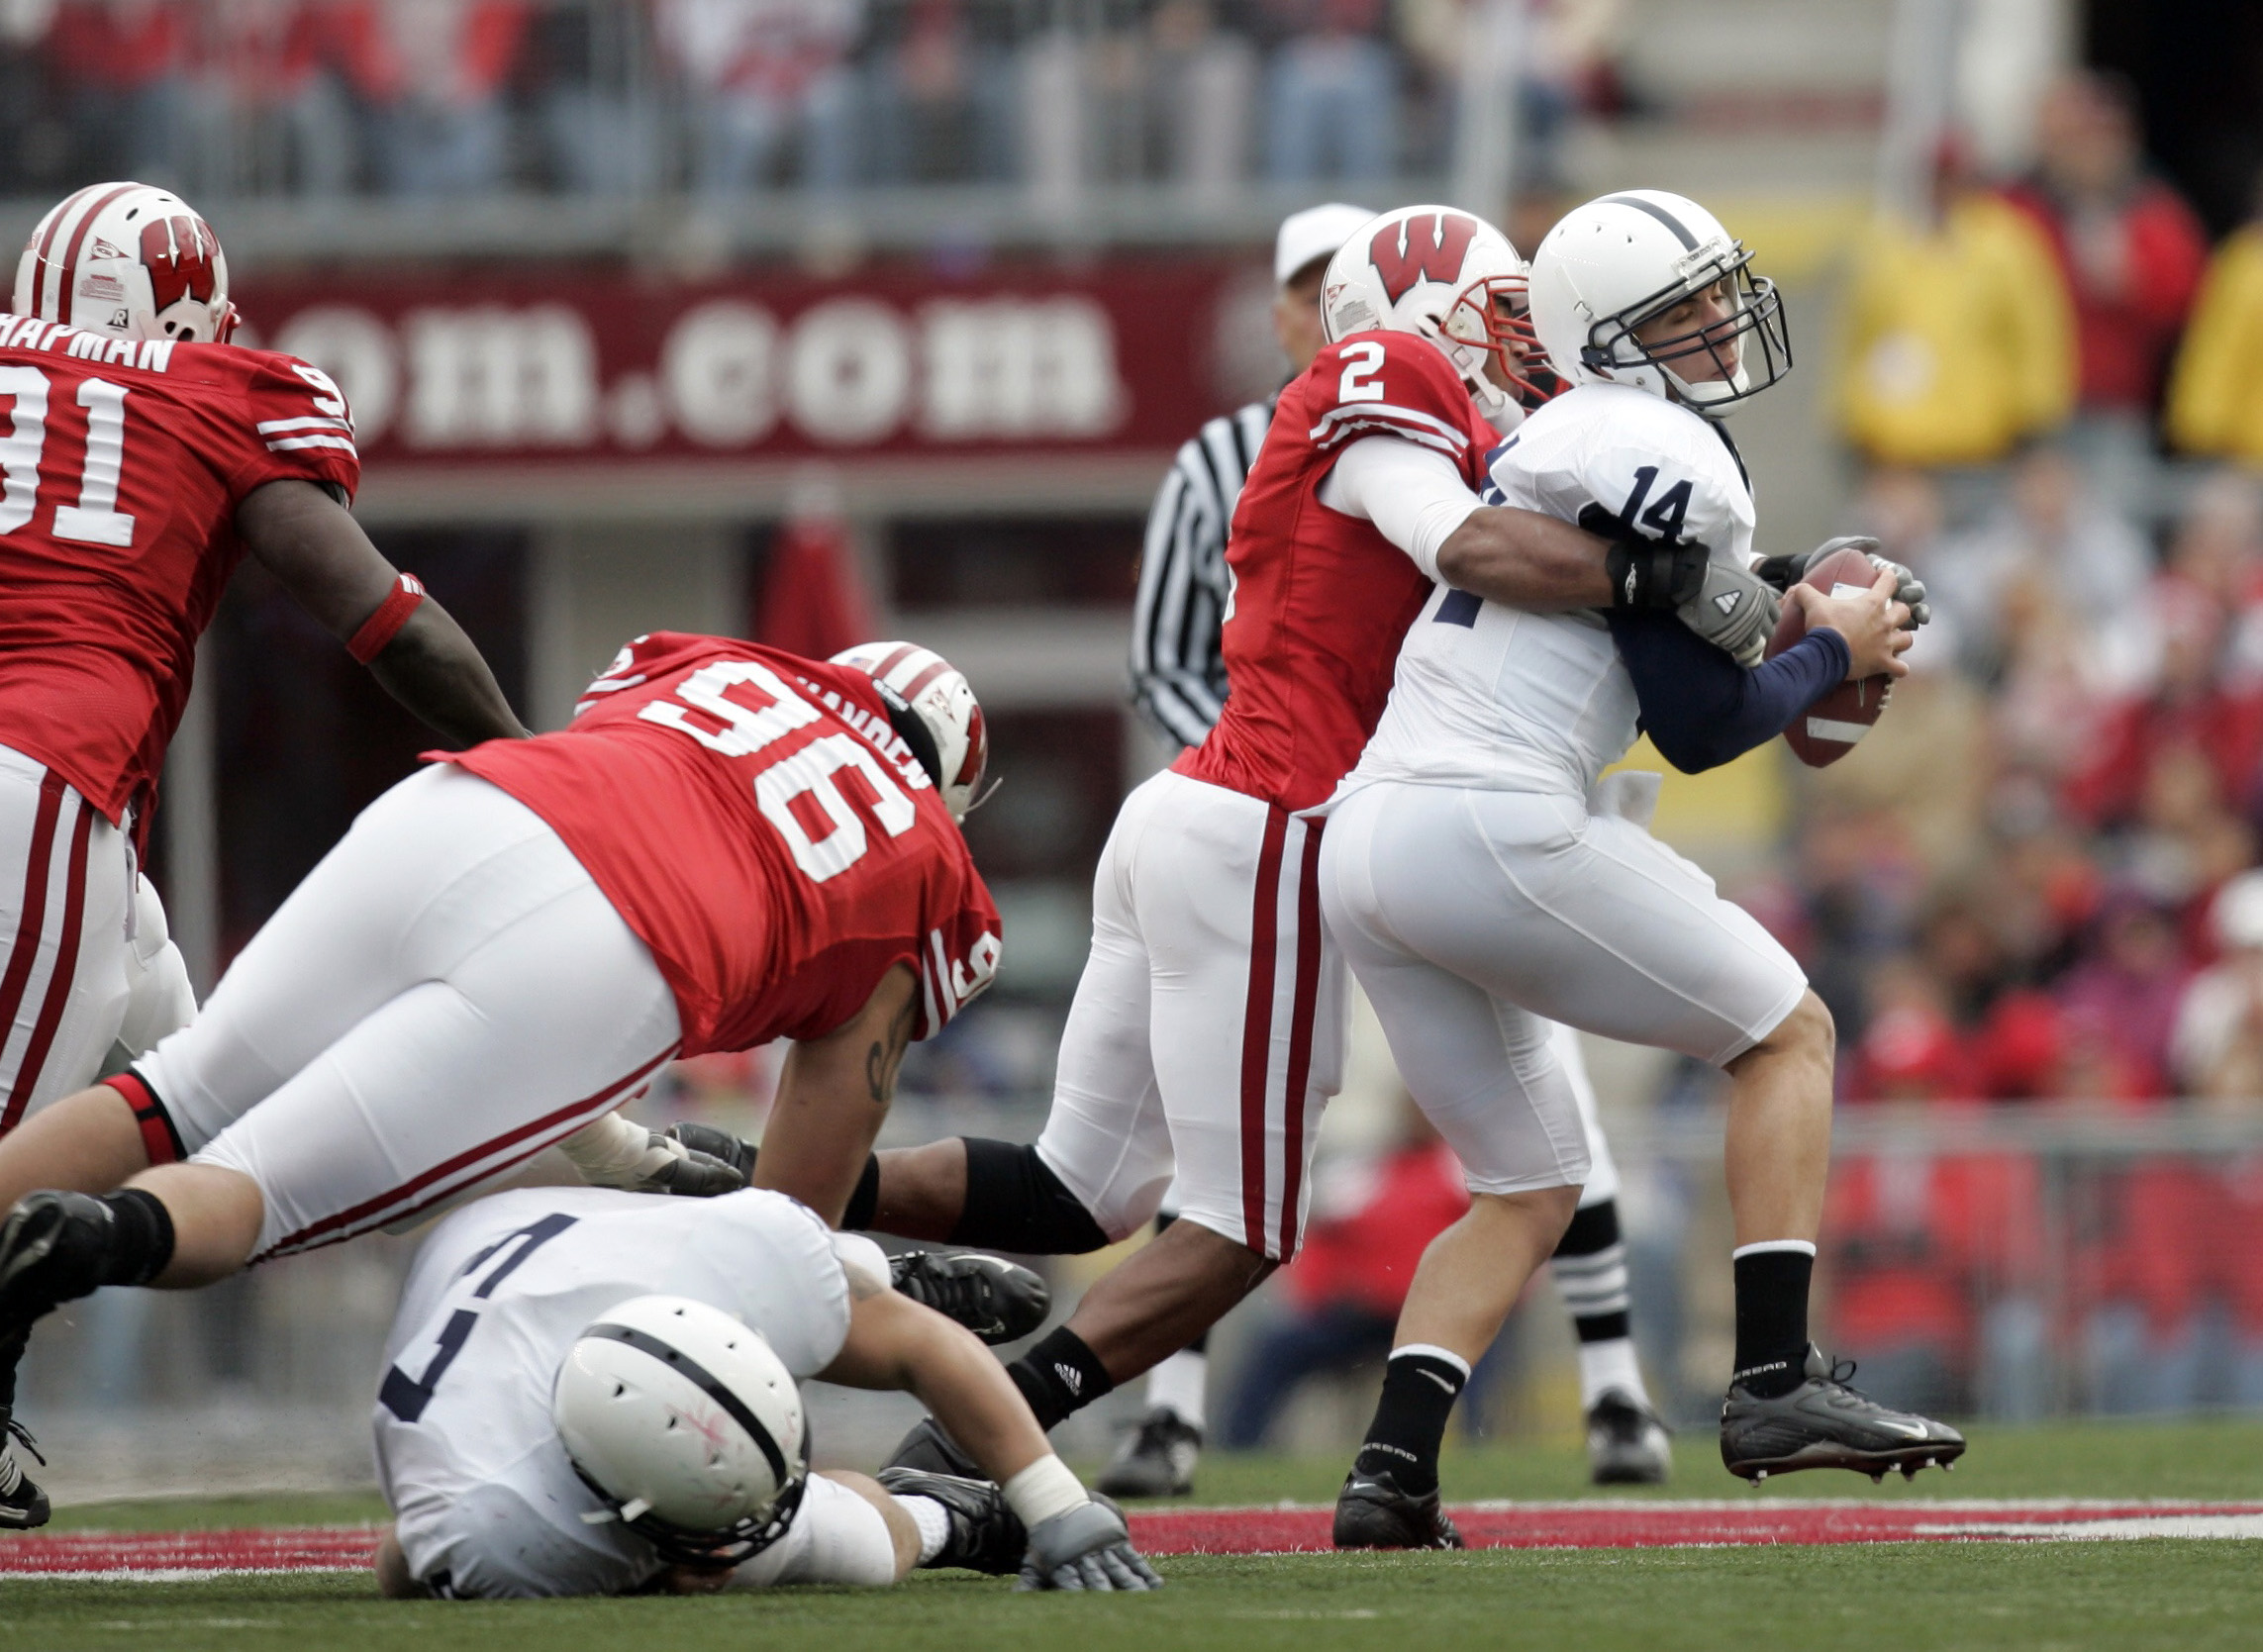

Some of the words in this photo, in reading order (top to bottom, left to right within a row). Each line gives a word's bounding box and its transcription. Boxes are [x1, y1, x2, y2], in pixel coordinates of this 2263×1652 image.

[1369, 213, 1478, 306] W
[238, 297, 1131, 450] om.com
[291, 363, 354, 430] 9
[1339, 341, 1385, 403] 2
[0, 365, 135, 547] 91
[1620, 465, 1694, 544] 14
[637, 660, 916, 884] 96
[951, 930, 1003, 1006] 9
